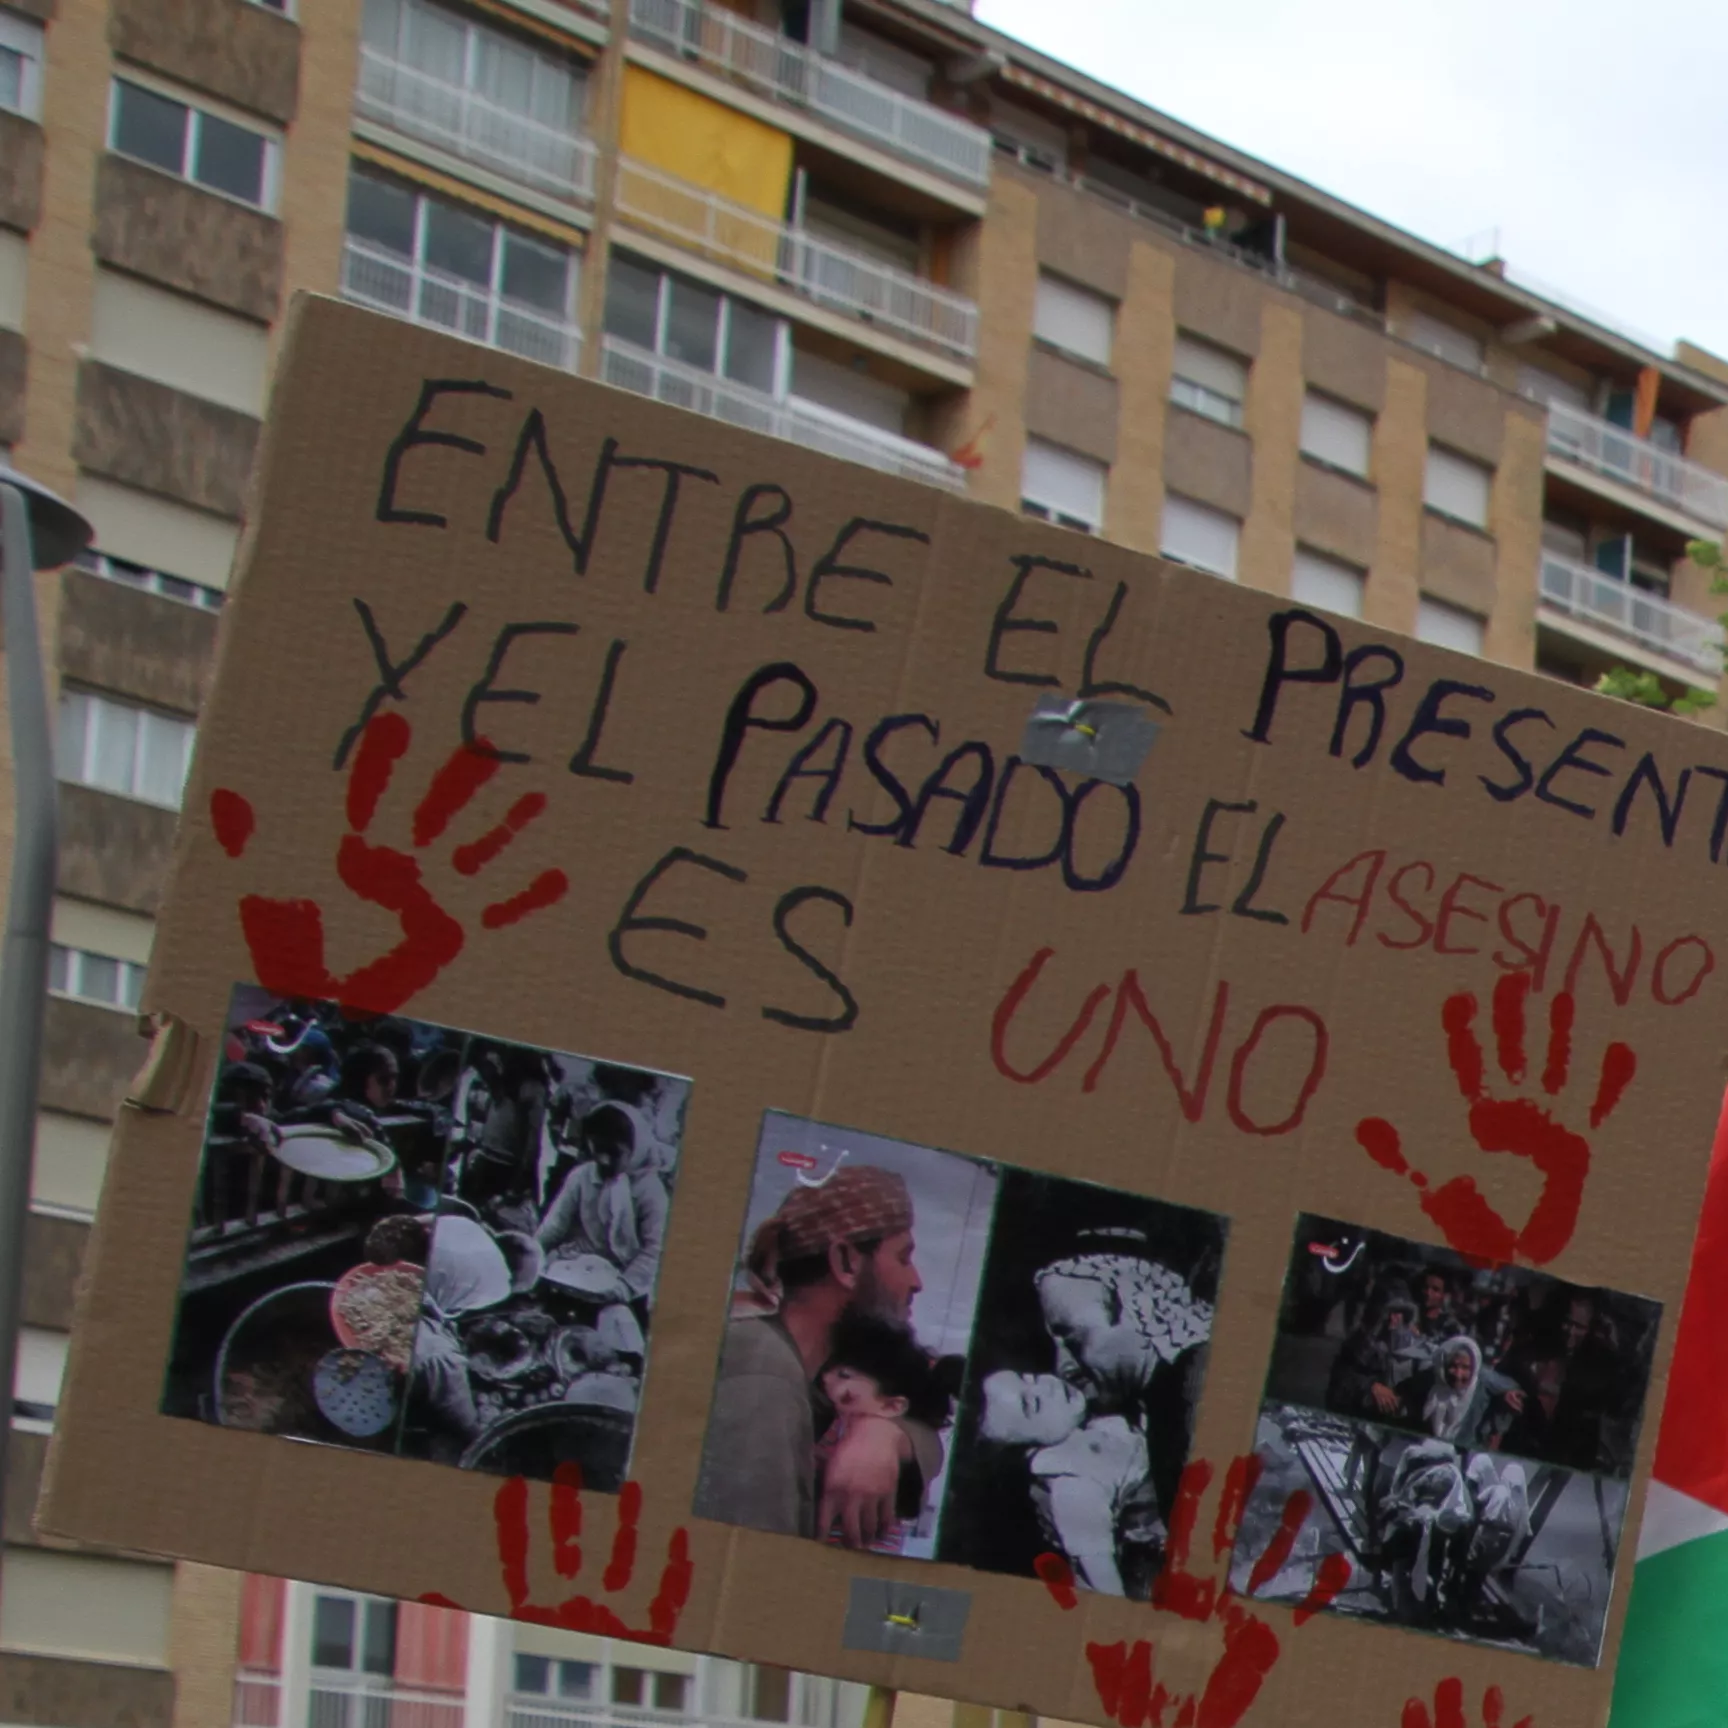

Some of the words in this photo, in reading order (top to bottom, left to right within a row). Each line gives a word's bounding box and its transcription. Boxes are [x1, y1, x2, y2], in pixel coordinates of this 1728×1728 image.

[375, 377, 931, 633] ENTRE
[984, 554, 1174, 716] EL
[608, 846, 860, 1033] ES
[990, 946, 1329, 1136] UNO
[702, 661, 1141, 891] PASADO
[1179, 800, 1290, 925] EL
[1300, 849, 1716, 1007] ASESINO
